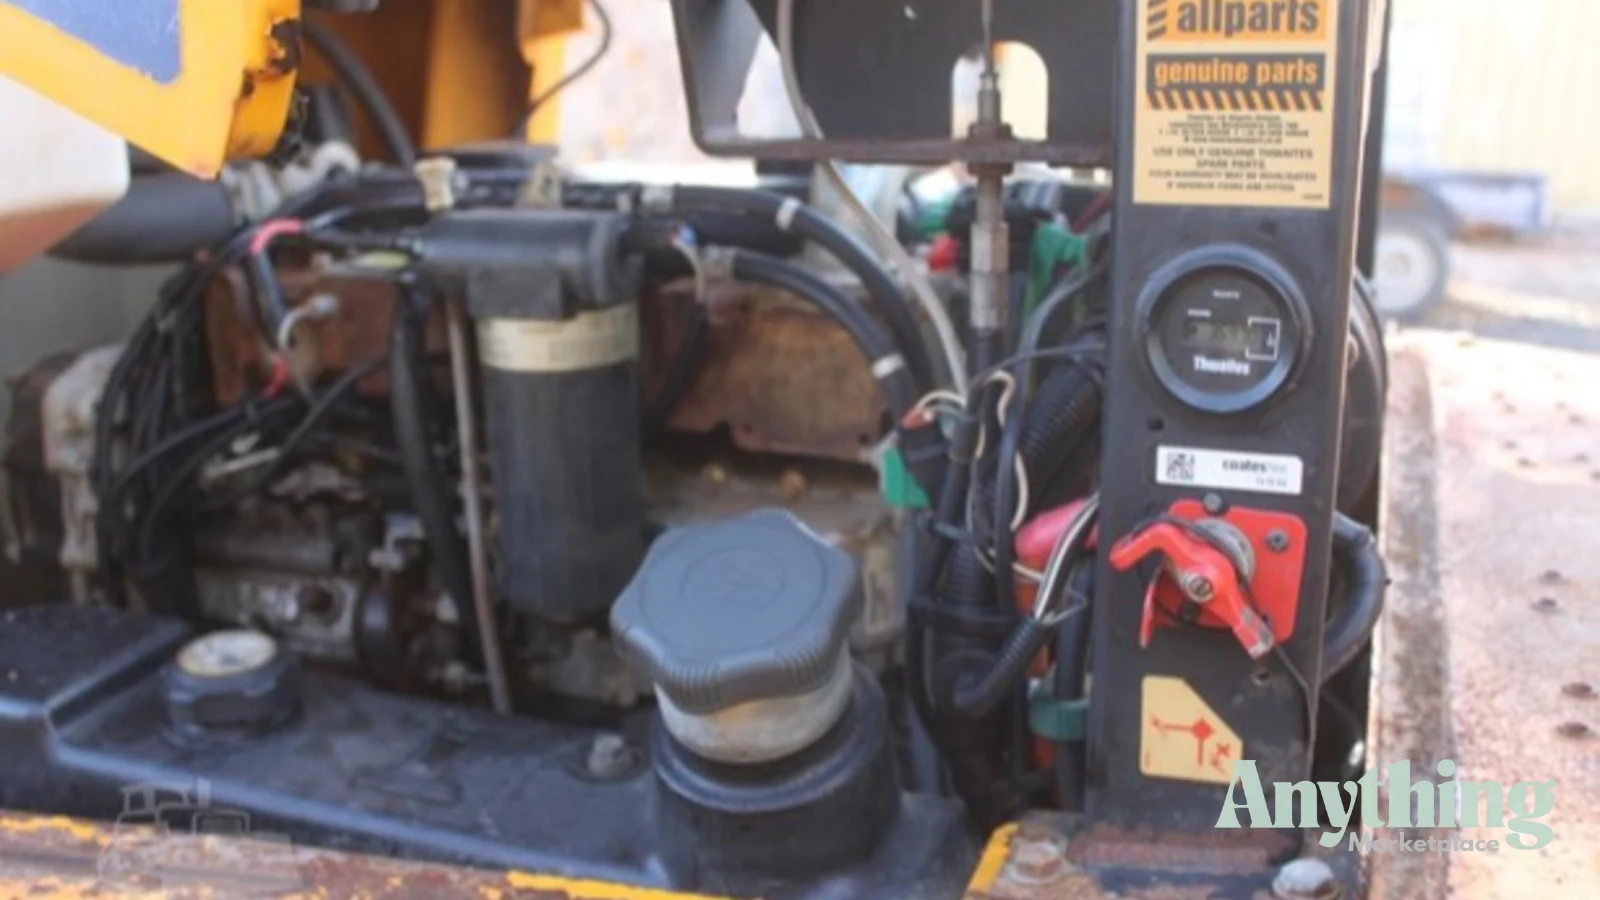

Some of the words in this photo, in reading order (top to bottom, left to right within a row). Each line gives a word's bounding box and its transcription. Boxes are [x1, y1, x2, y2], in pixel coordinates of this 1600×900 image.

[1177, 0, 1319, 38] allparts
[1155, 58, 1248, 87] genuine
[1256, 59, 1318, 87] parts
[1207, 148, 1255, 159] GENUINE
